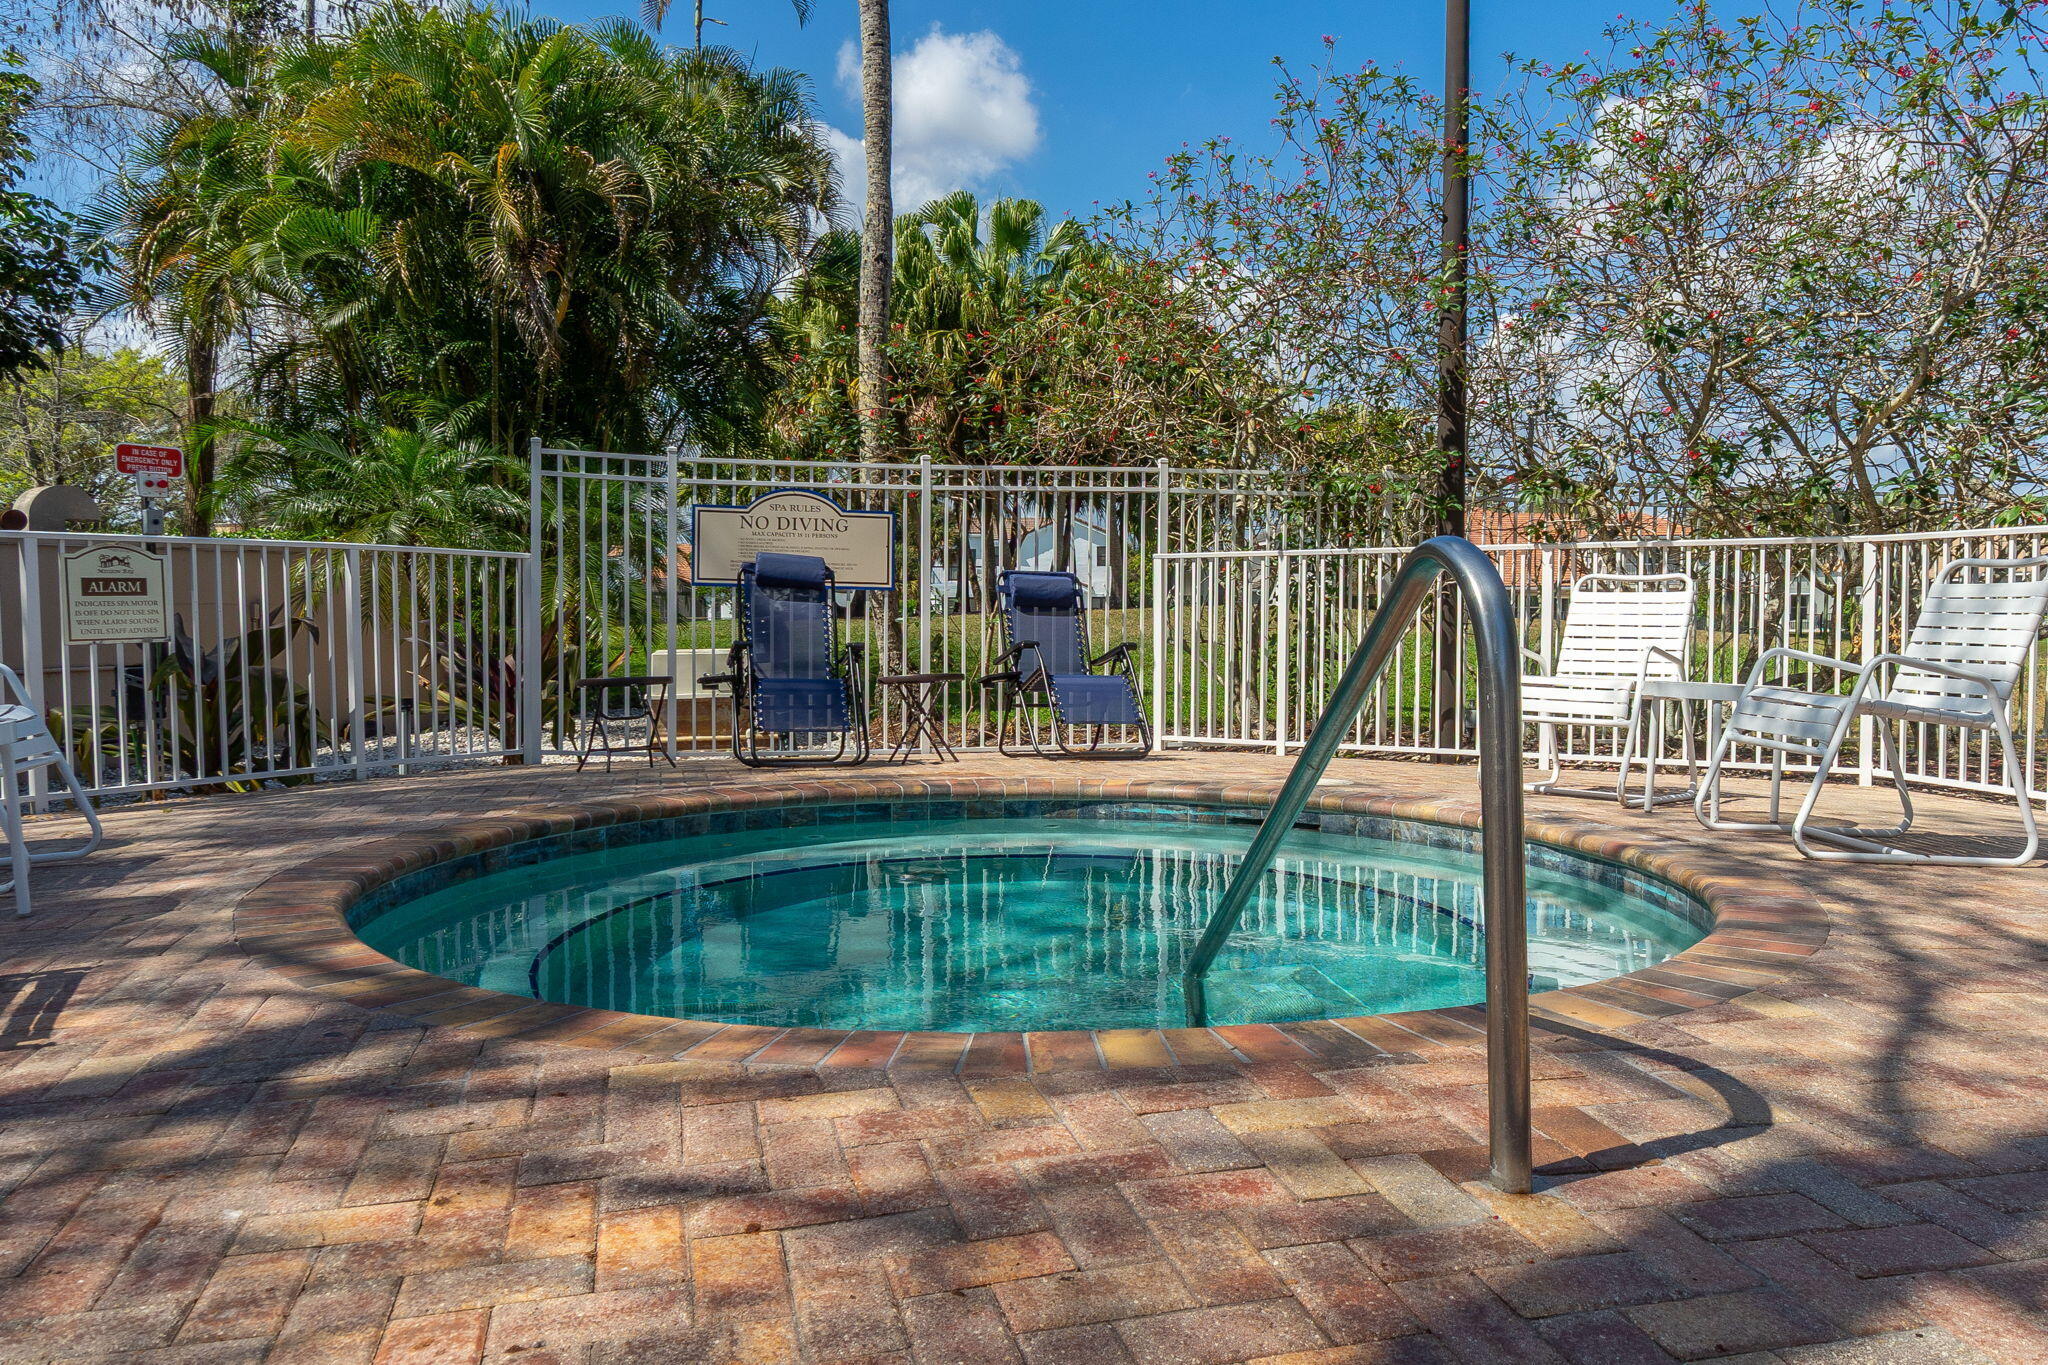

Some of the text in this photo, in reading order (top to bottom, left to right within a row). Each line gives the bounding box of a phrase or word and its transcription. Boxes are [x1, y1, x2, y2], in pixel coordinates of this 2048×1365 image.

[122, 456, 160, 465] EMERGENCY
[770, 504, 821, 512] SPA RULES
[740, 515, 849, 532] NO DIVING
[88, 581, 141, 592] ALARM
